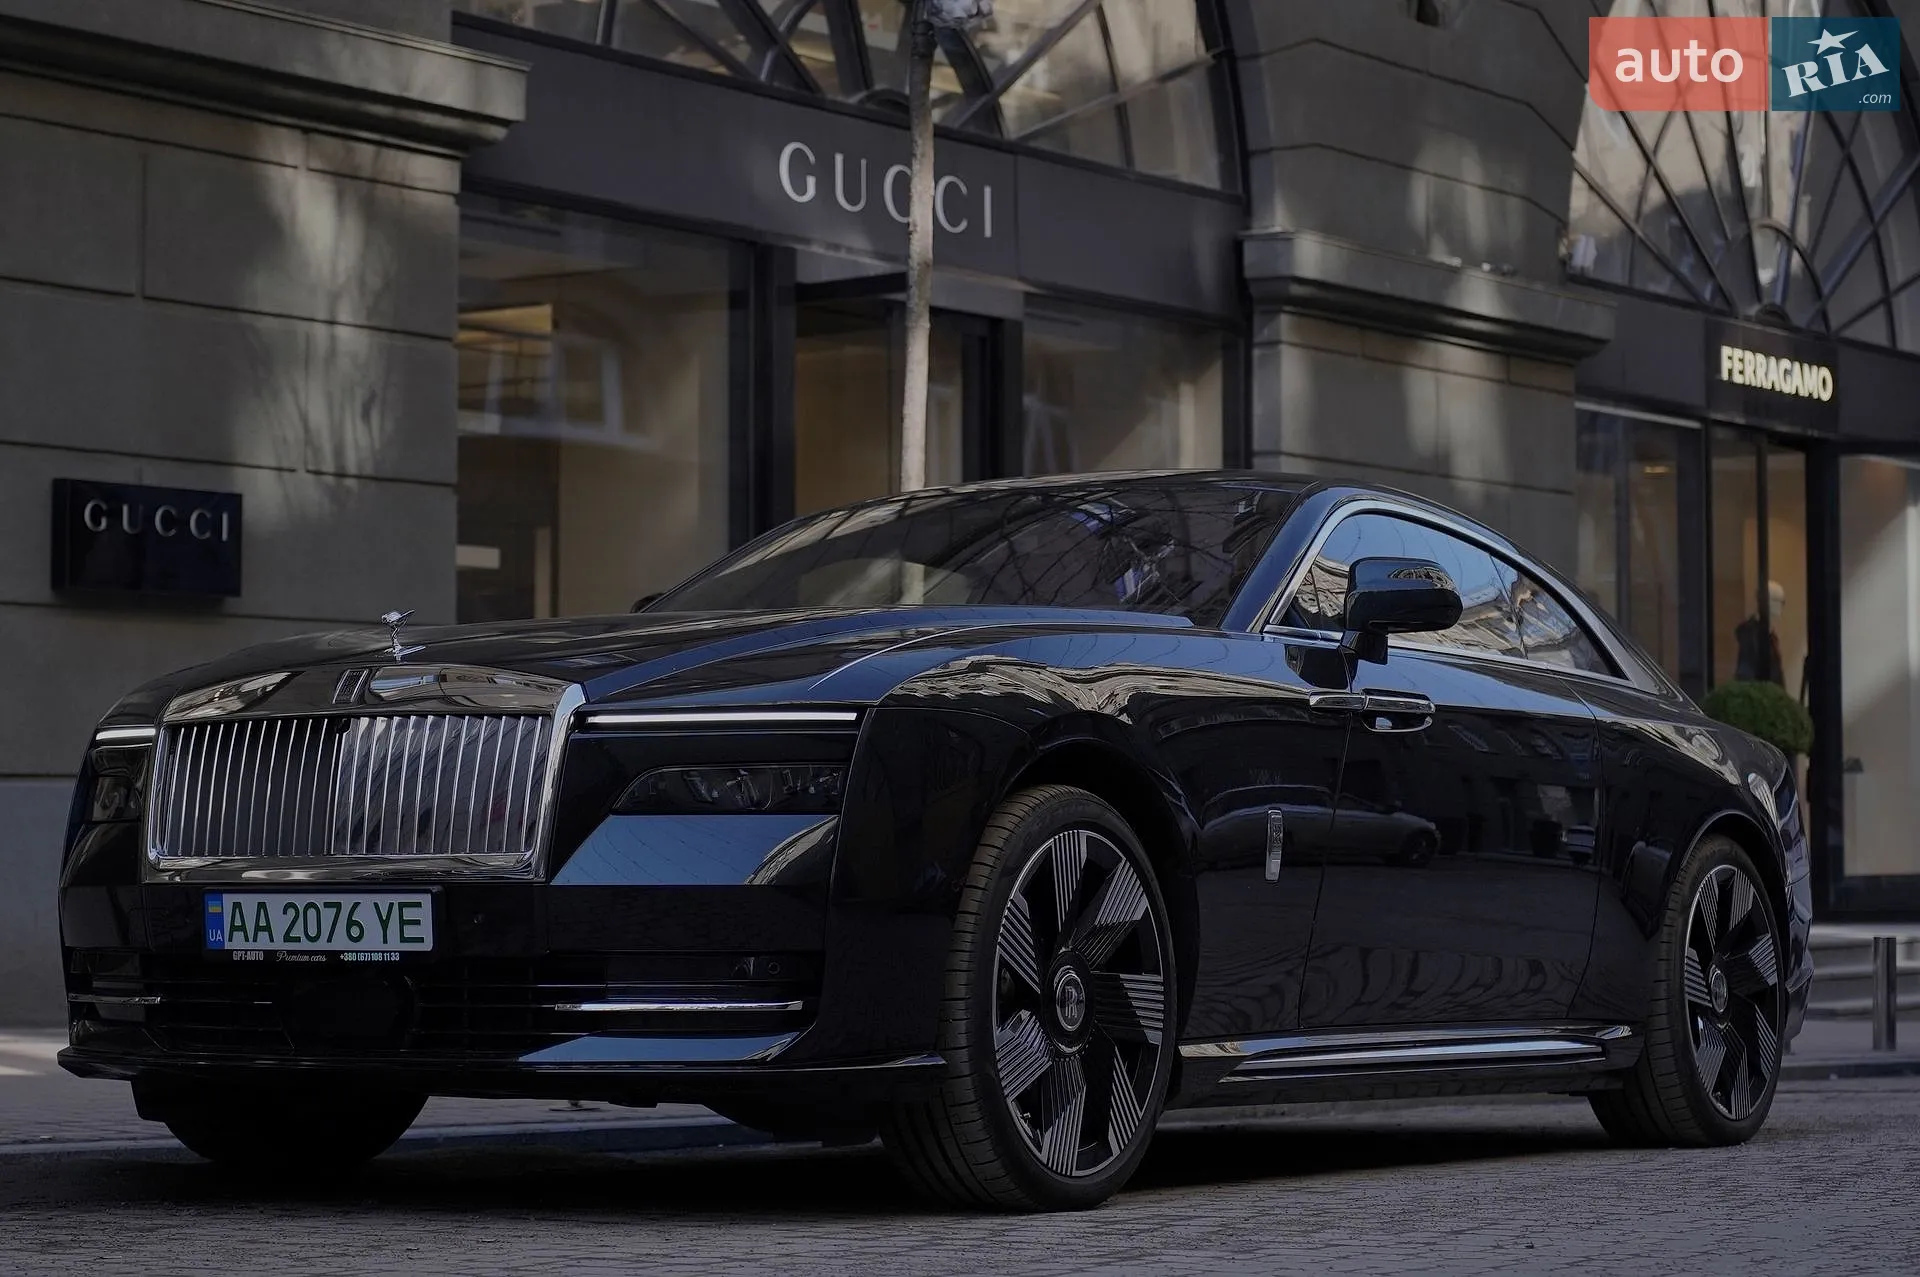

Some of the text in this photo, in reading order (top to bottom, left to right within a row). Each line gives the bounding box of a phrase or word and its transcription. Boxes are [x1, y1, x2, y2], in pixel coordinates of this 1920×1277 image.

[779, 141, 992, 238] GUCCI
[1720, 344, 1834, 402] FERRAGAMO
[83, 499, 229, 542] GUCCI
[209, 929, 223, 942] UA
[227, 901, 425, 944] AA 2076 YE
[310, 954, 327, 962] cars
